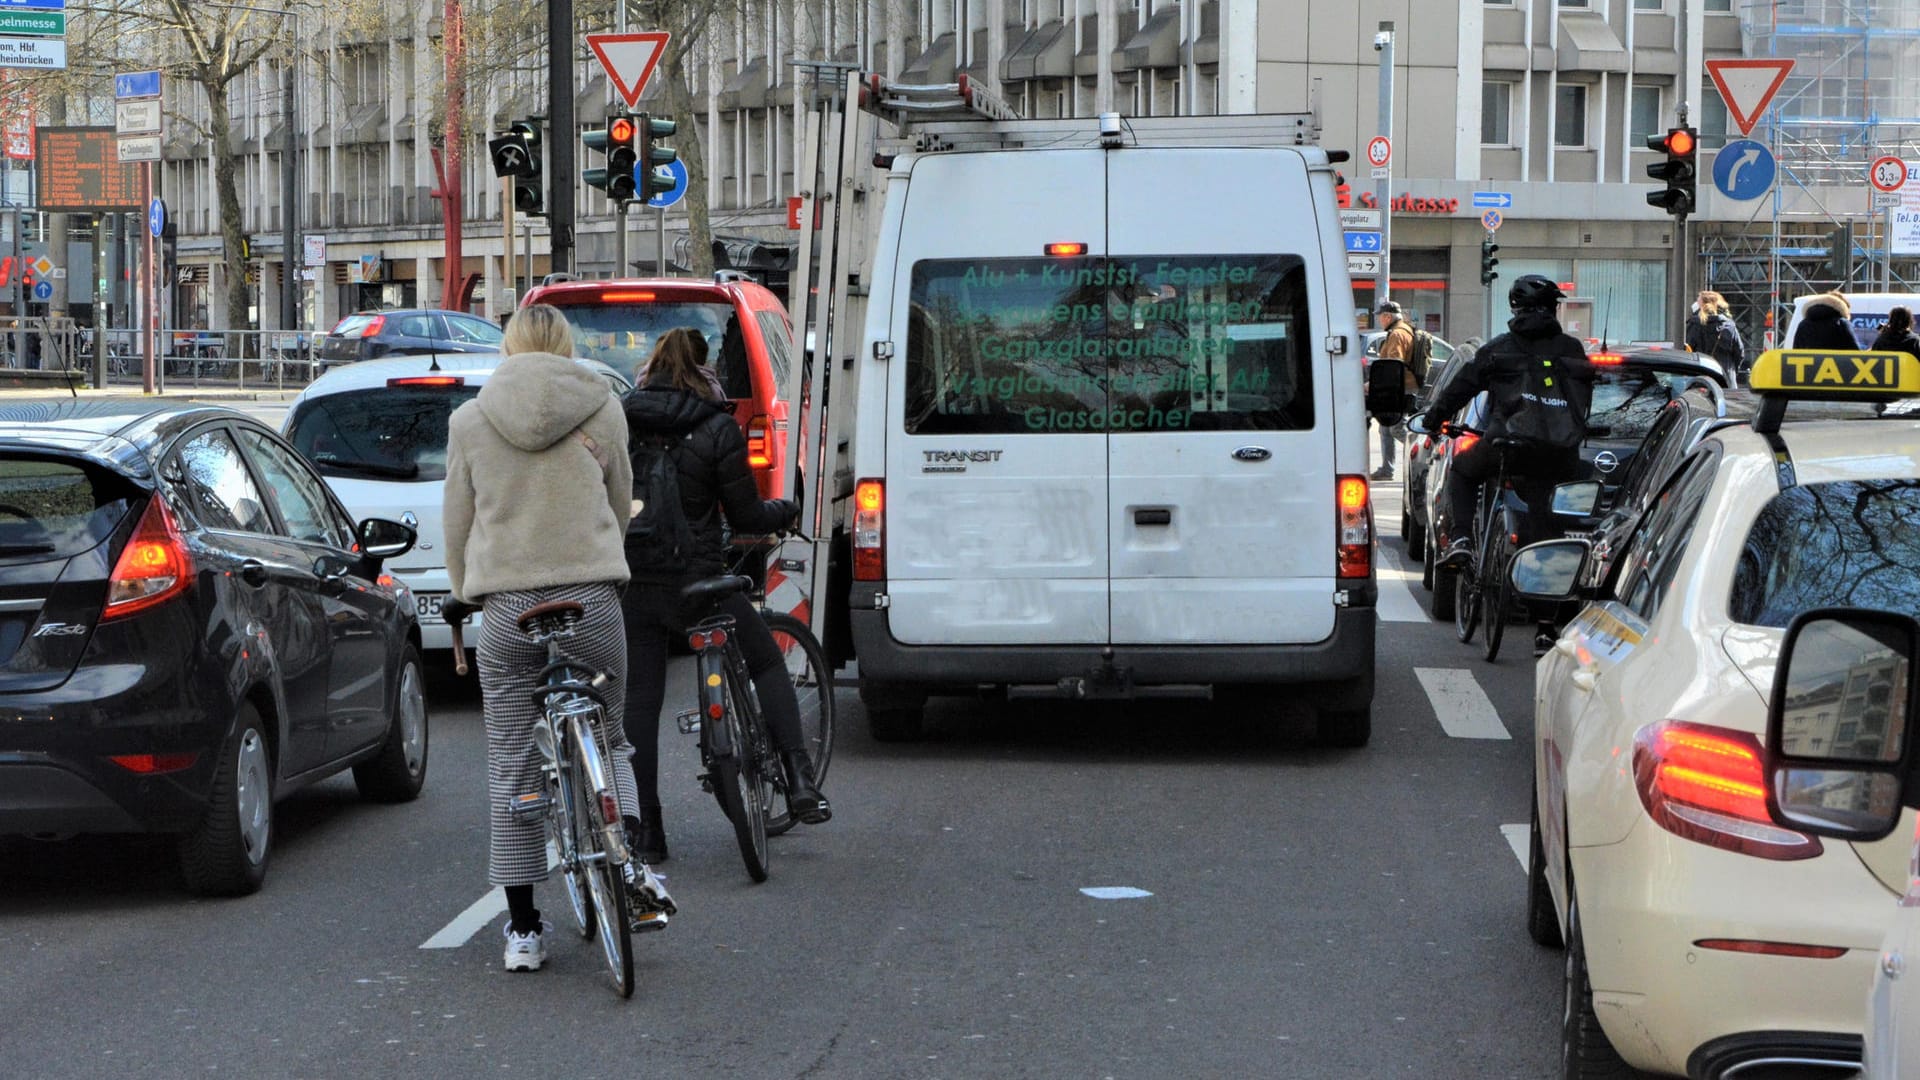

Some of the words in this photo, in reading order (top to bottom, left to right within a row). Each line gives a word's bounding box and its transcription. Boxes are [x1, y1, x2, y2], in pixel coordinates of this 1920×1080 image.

[961, 265, 1005, 288] Alu
[1156, 261, 1257, 286] Fenster
[1787, 357, 1894, 385] TAXI
[1024, 404, 1195, 429] Glasdächer
[923, 450, 1003, 462] TRANSIT
